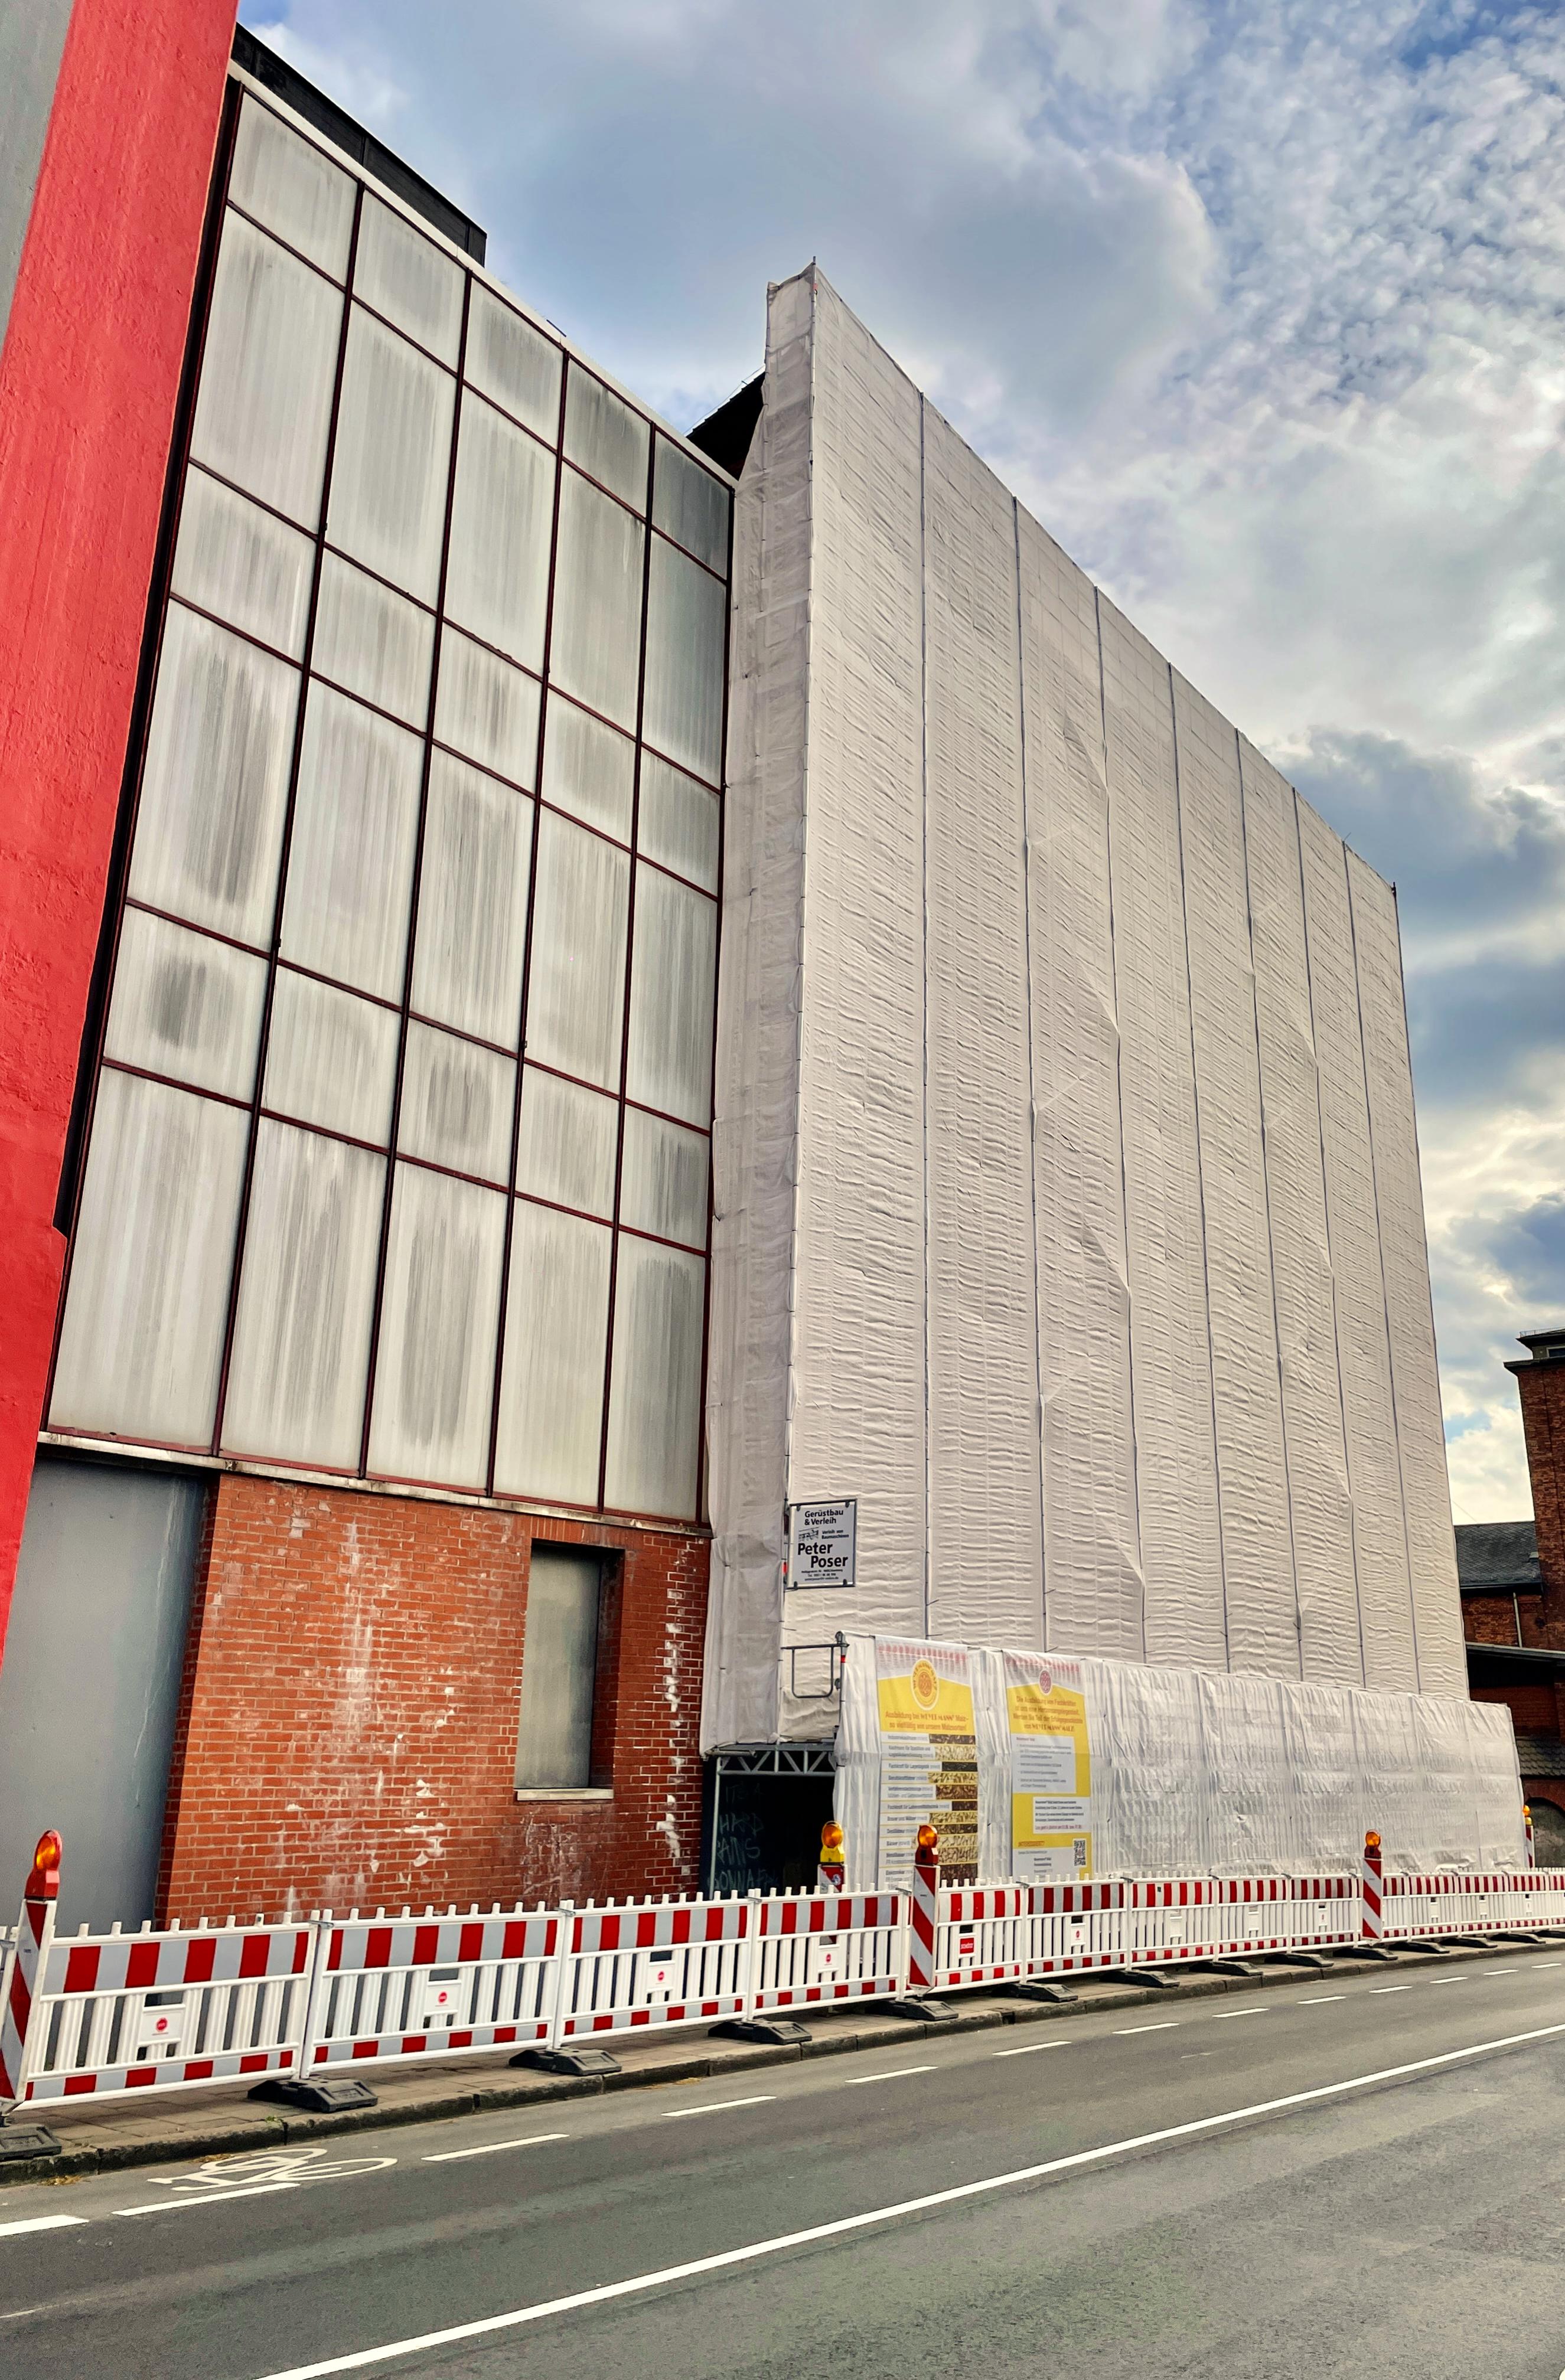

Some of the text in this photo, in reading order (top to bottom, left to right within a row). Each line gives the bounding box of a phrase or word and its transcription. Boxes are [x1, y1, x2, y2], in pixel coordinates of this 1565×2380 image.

[805, 1509, 843, 1517] Gerüstbau
[798, 1542, 833, 1555] Peter
[811, 1556, 849, 1568] Poser
[719, 1812, 765, 1837] HARD
